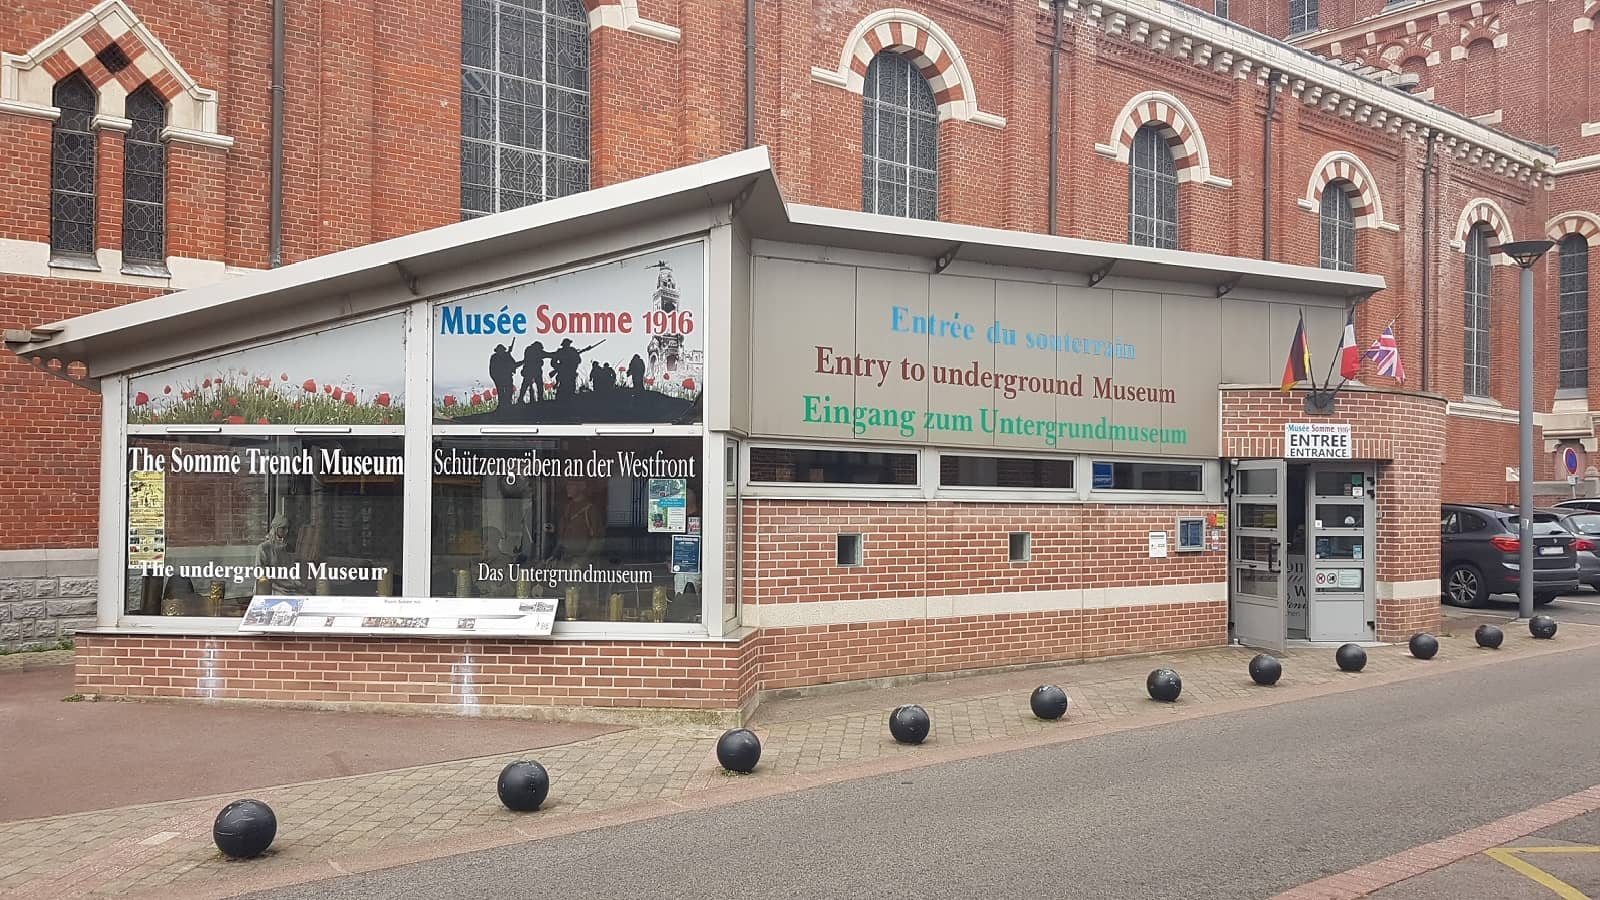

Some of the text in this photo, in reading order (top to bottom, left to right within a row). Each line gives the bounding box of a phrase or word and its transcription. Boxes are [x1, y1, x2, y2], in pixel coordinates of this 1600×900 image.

[441, 304, 693, 334] Musée Somme 1916
[891, 305, 1137, 360] Entrée du souterrain
[815, 346, 1177, 404] Entry to underground Museum
[802, 395, 1188, 446] Eingang zum Untergrundmuseum
[1288, 424, 1309, 433] Musée
[1311, 424, 1335, 433] Somme
[1290, 434, 1347, 447] ENTREE
[1290, 448, 1347, 458] ENTRANCE
[129, 447, 404, 476] The Somme Trench Museum
[433, 448, 696, 484] Schützengräben an der Westfront
[141, 560, 174, 577] The
[180, 562, 301, 583] underground
[478, 562, 653, 587] Das Untergrundmuseum
